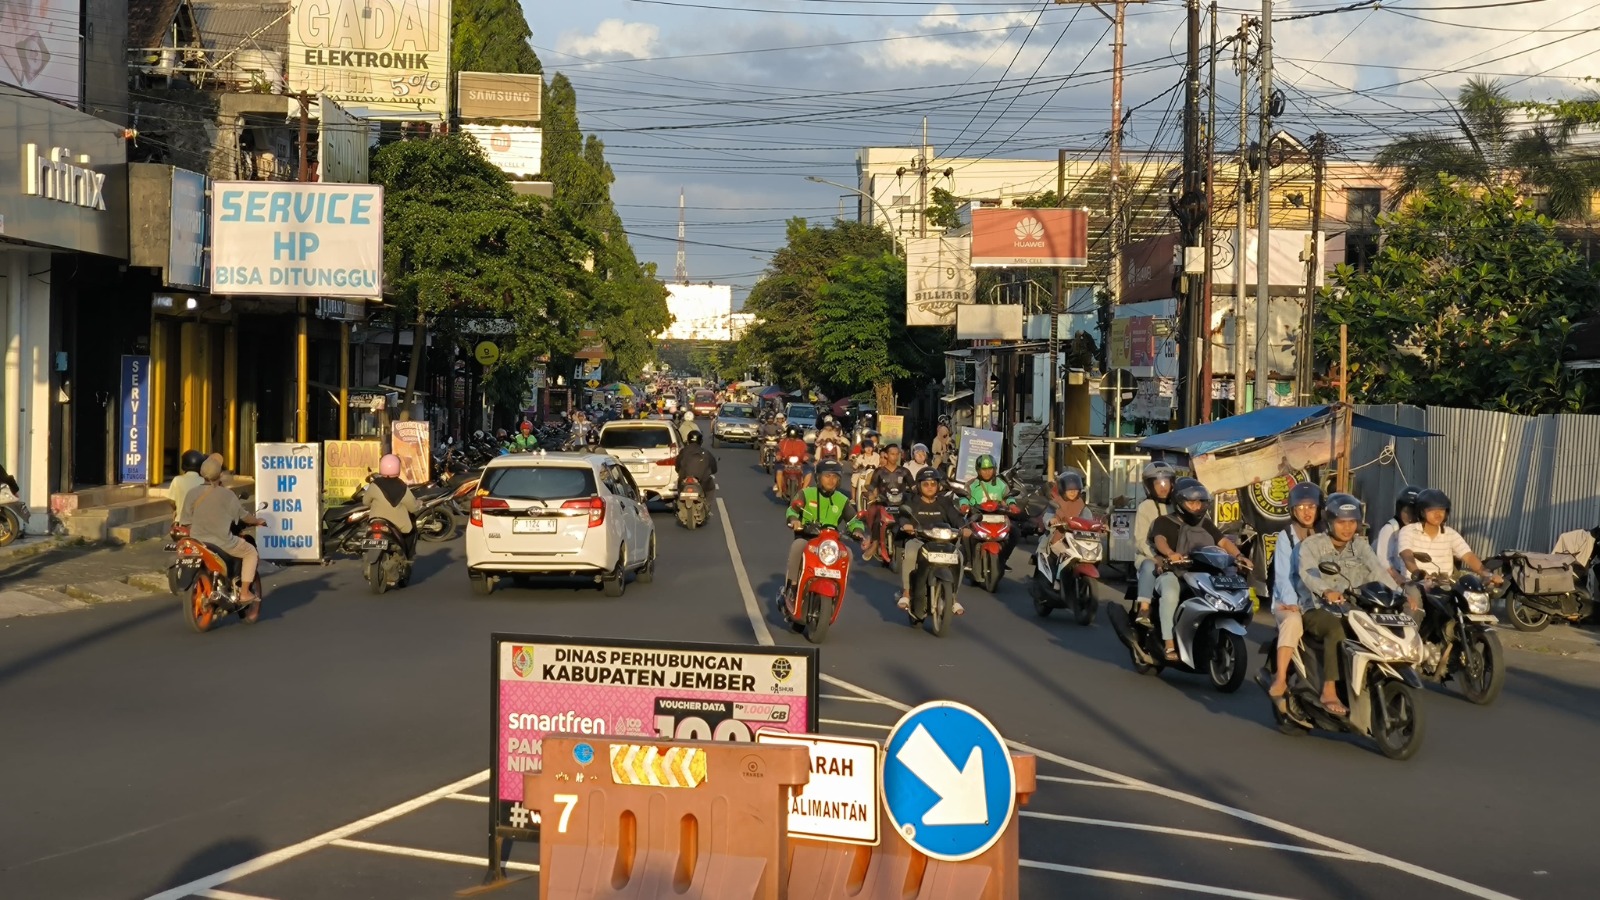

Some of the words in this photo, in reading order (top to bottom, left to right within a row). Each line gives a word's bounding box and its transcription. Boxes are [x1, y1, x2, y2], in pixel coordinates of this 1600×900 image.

[298, 0, 440, 51] GADAI
[305, 50, 429, 69] ELEKTRONIK
[390, 72, 440, 96] 5%
[469, 90, 530, 102] SAMSUNG
[219, 190, 374, 225] SERVICE
[273, 231, 320, 261] HP
[216, 267, 262, 286] BISA
[269, 268, 377, 288] DITUNGGU
[915, 291, 969, 301] BILLIARD
[129, 361, 140, 453] SERVICE
[125, 454, 141, 466] HP
[262, 456, 314, 469] SERVICE
[327, 442, 379, 468] GADAI
[277, 475, 297, 492] HP
[273, 499, 302, 512] BISA
[281, 518, 293, 531] DI
[263, 535, 313, 548] TUNGGU
[555, 649, 607, 663] DINAS
[610, 652, 743, 671] PERHUBUNGAN
[543, 664, 665, 687] KABUPATEN
[670, 671, 756, 692] JEMBER
[660, 700, 701, 711] VOUCHER
[702, 703, 726, 712] DATA
[508, 711, 605, 735] smartfren
[554, 794, 578, 833] 7
[787, 798, 867, 822] ALIMANTAN
